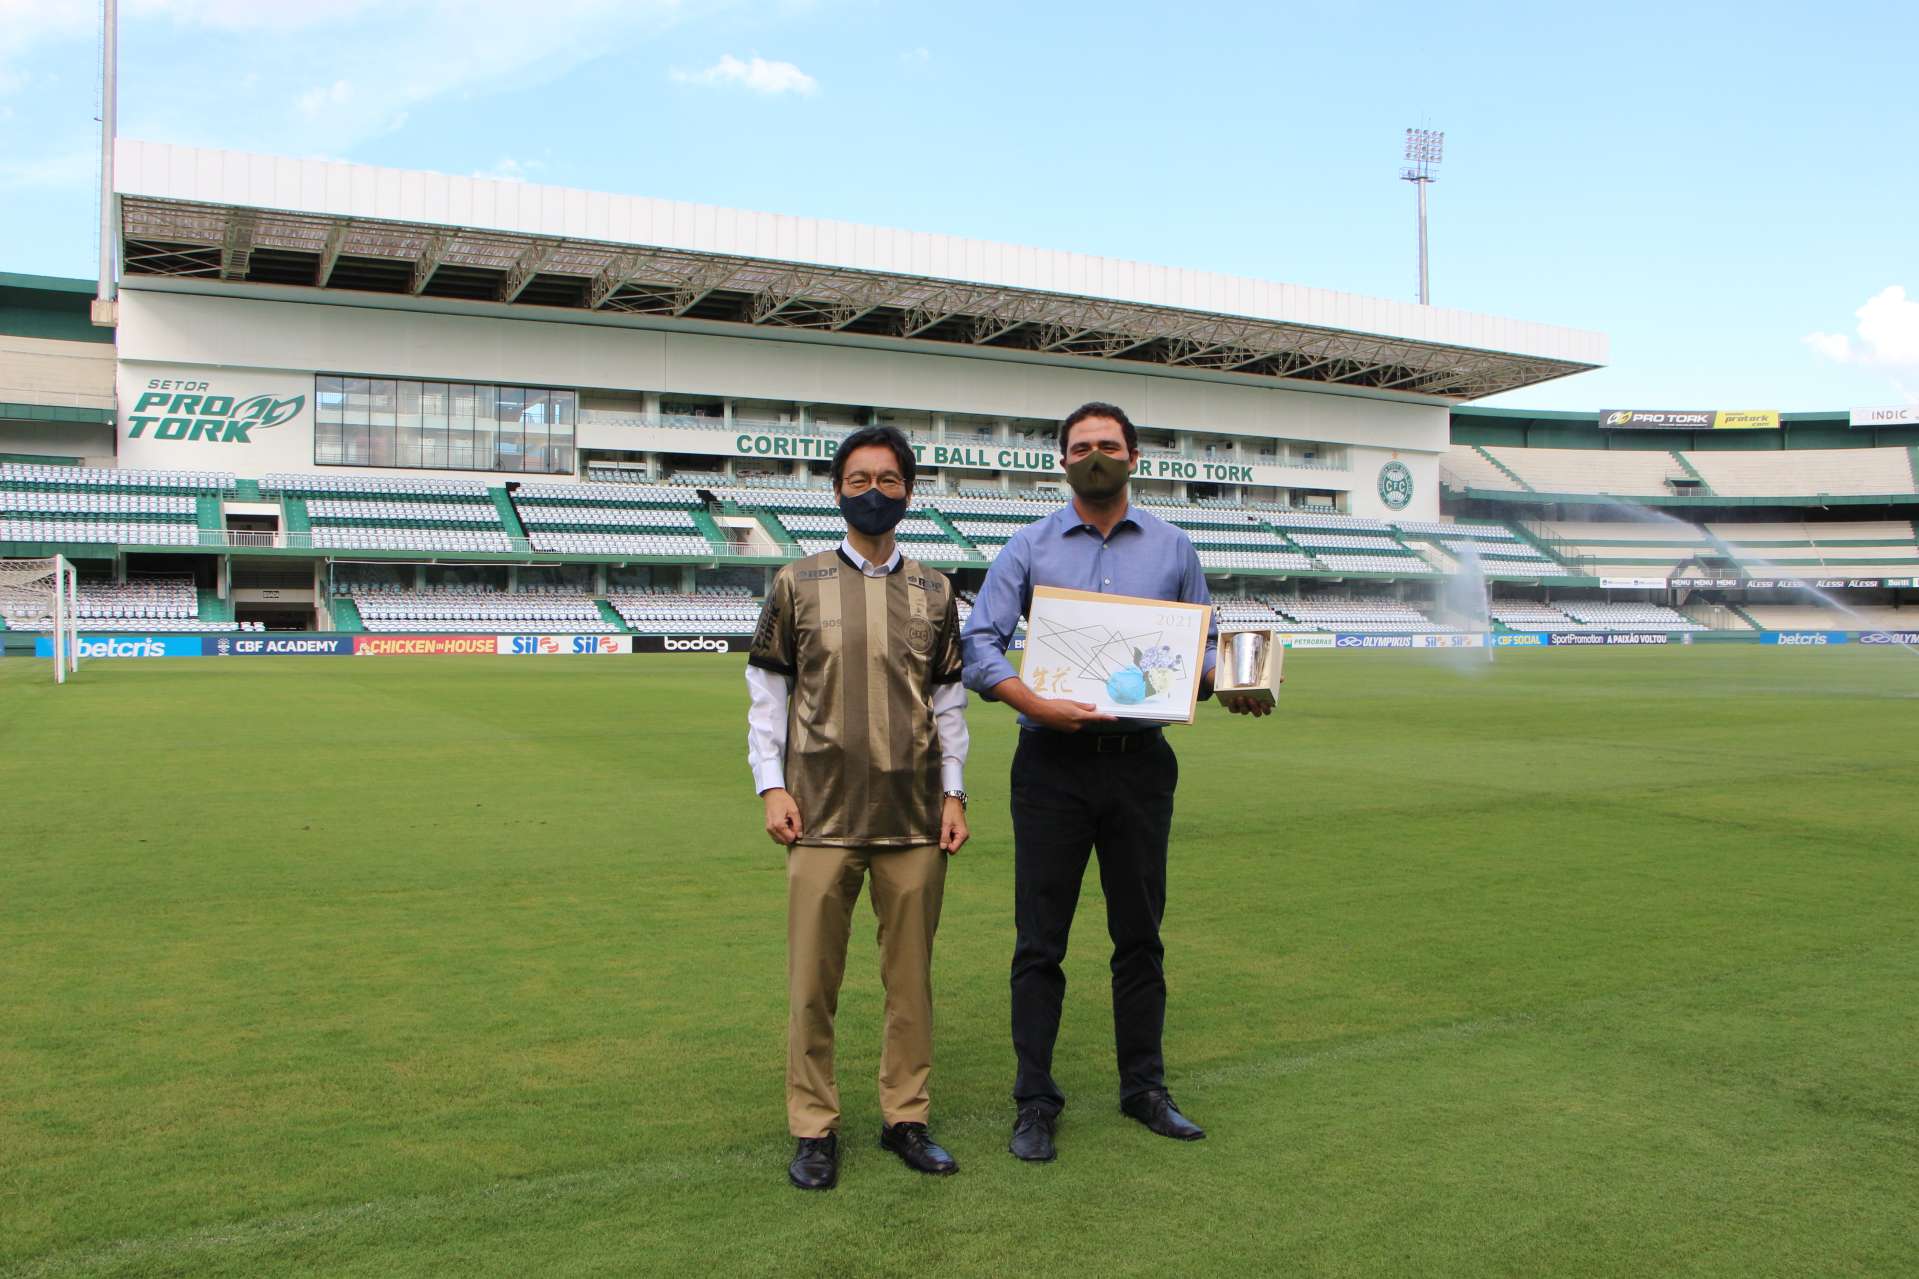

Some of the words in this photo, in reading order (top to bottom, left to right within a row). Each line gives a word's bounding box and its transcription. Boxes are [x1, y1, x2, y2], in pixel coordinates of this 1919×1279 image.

[147, 379, 210, 392] SETOR
[133, 392, 236, 416] PRO
[1632, 413, 1665, 423] PRO
[1665, 414, 1709, 423] TORK
[127, 415, 257, 444] TORK
[736, 434, 840, 458] CORITIB
[934, 446, 991, 466] BALL
[997, 450, 1055, 470] CLUB
[1158, 461, 1197, 478] PRO
[1203, 463, 1254, 482] TORK
[1386, 480, 1406, 492] CFC
[1815, 580, 1844, 588] ALESSI
[1848, 580, 1878, 588] ALESSI
[1156, 614, 1193, 628] 2021
[663, 636, 729, 653] bodog
[1362, 636, 1412, 647] OLYMPIKUS
[1551, 634, 1604, 645] SportPromotion
[1606, 634, 1613, 644] A
[1613, 632, 1640, 644] PAIXÃO
[1640, 634, 1668, 644] VOLTOU
[1777, 632, 1828, 645] betcris
[77, 637, 166, 658] betcris
[235, 640, 264, 653] CBF
[265, 640, 339, 653] ACADEMY
[370, 639, 436, 654] CHICKEN
[444, 639, 496, 653] HOUSE
[511, 636, 538, 654] Sil
[571, 636, 598, 654] Sil
